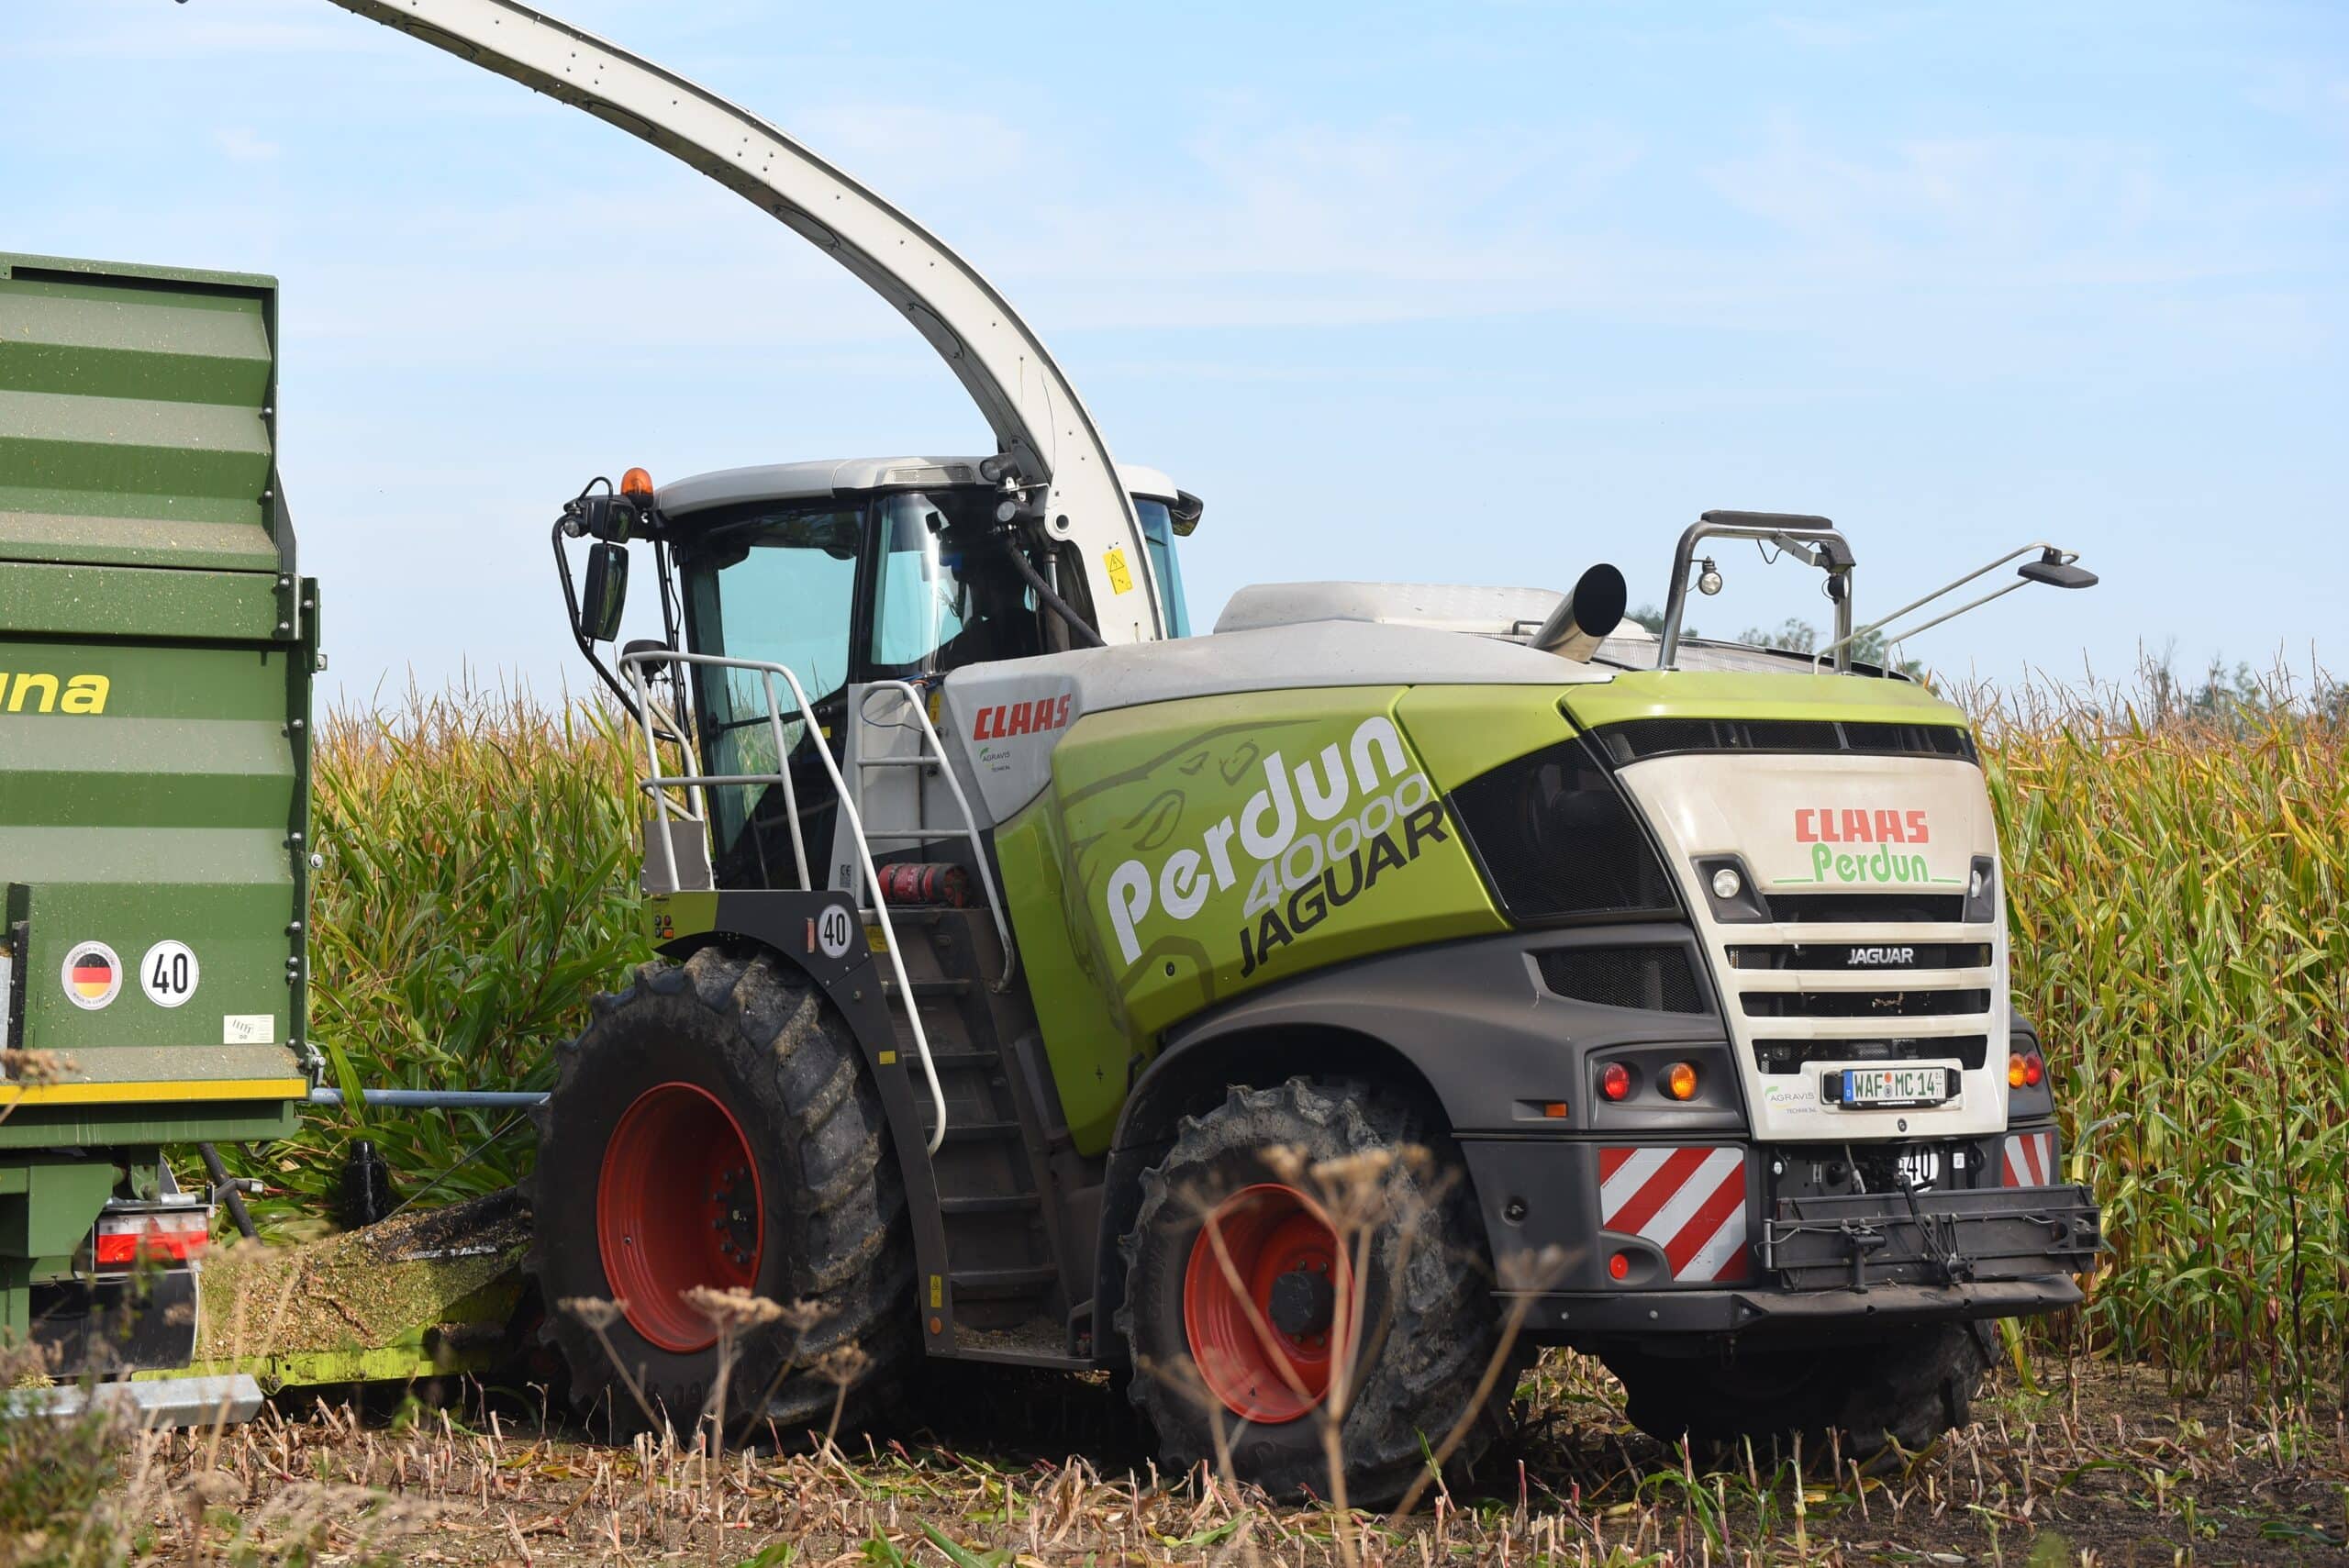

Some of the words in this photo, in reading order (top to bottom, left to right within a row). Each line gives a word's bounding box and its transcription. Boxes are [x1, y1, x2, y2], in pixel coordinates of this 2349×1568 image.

[0, 673, 110, 714] na
[974, 694, 1072, 741] CLAAS
[1795, 808, 1929, 843] CLAAS
[1811, 842, 1929, 882] Perdun
[1239, 800, 1449, 978] JAGUAR
[824, 913, 846, 947] 40
[152, 952, 188, 995] 40
[1847, 948, 1914, 964] JAGUAR
[1770, 1092, 1815, 1102] AGRAVIS
[1854, 1073, 1883, 1097] WAF
[1895, 1072, 1914, 1096] MC
[1918, 1072, 1935, 1096] 14
[1907, 1145, 1931, 1182] 40
